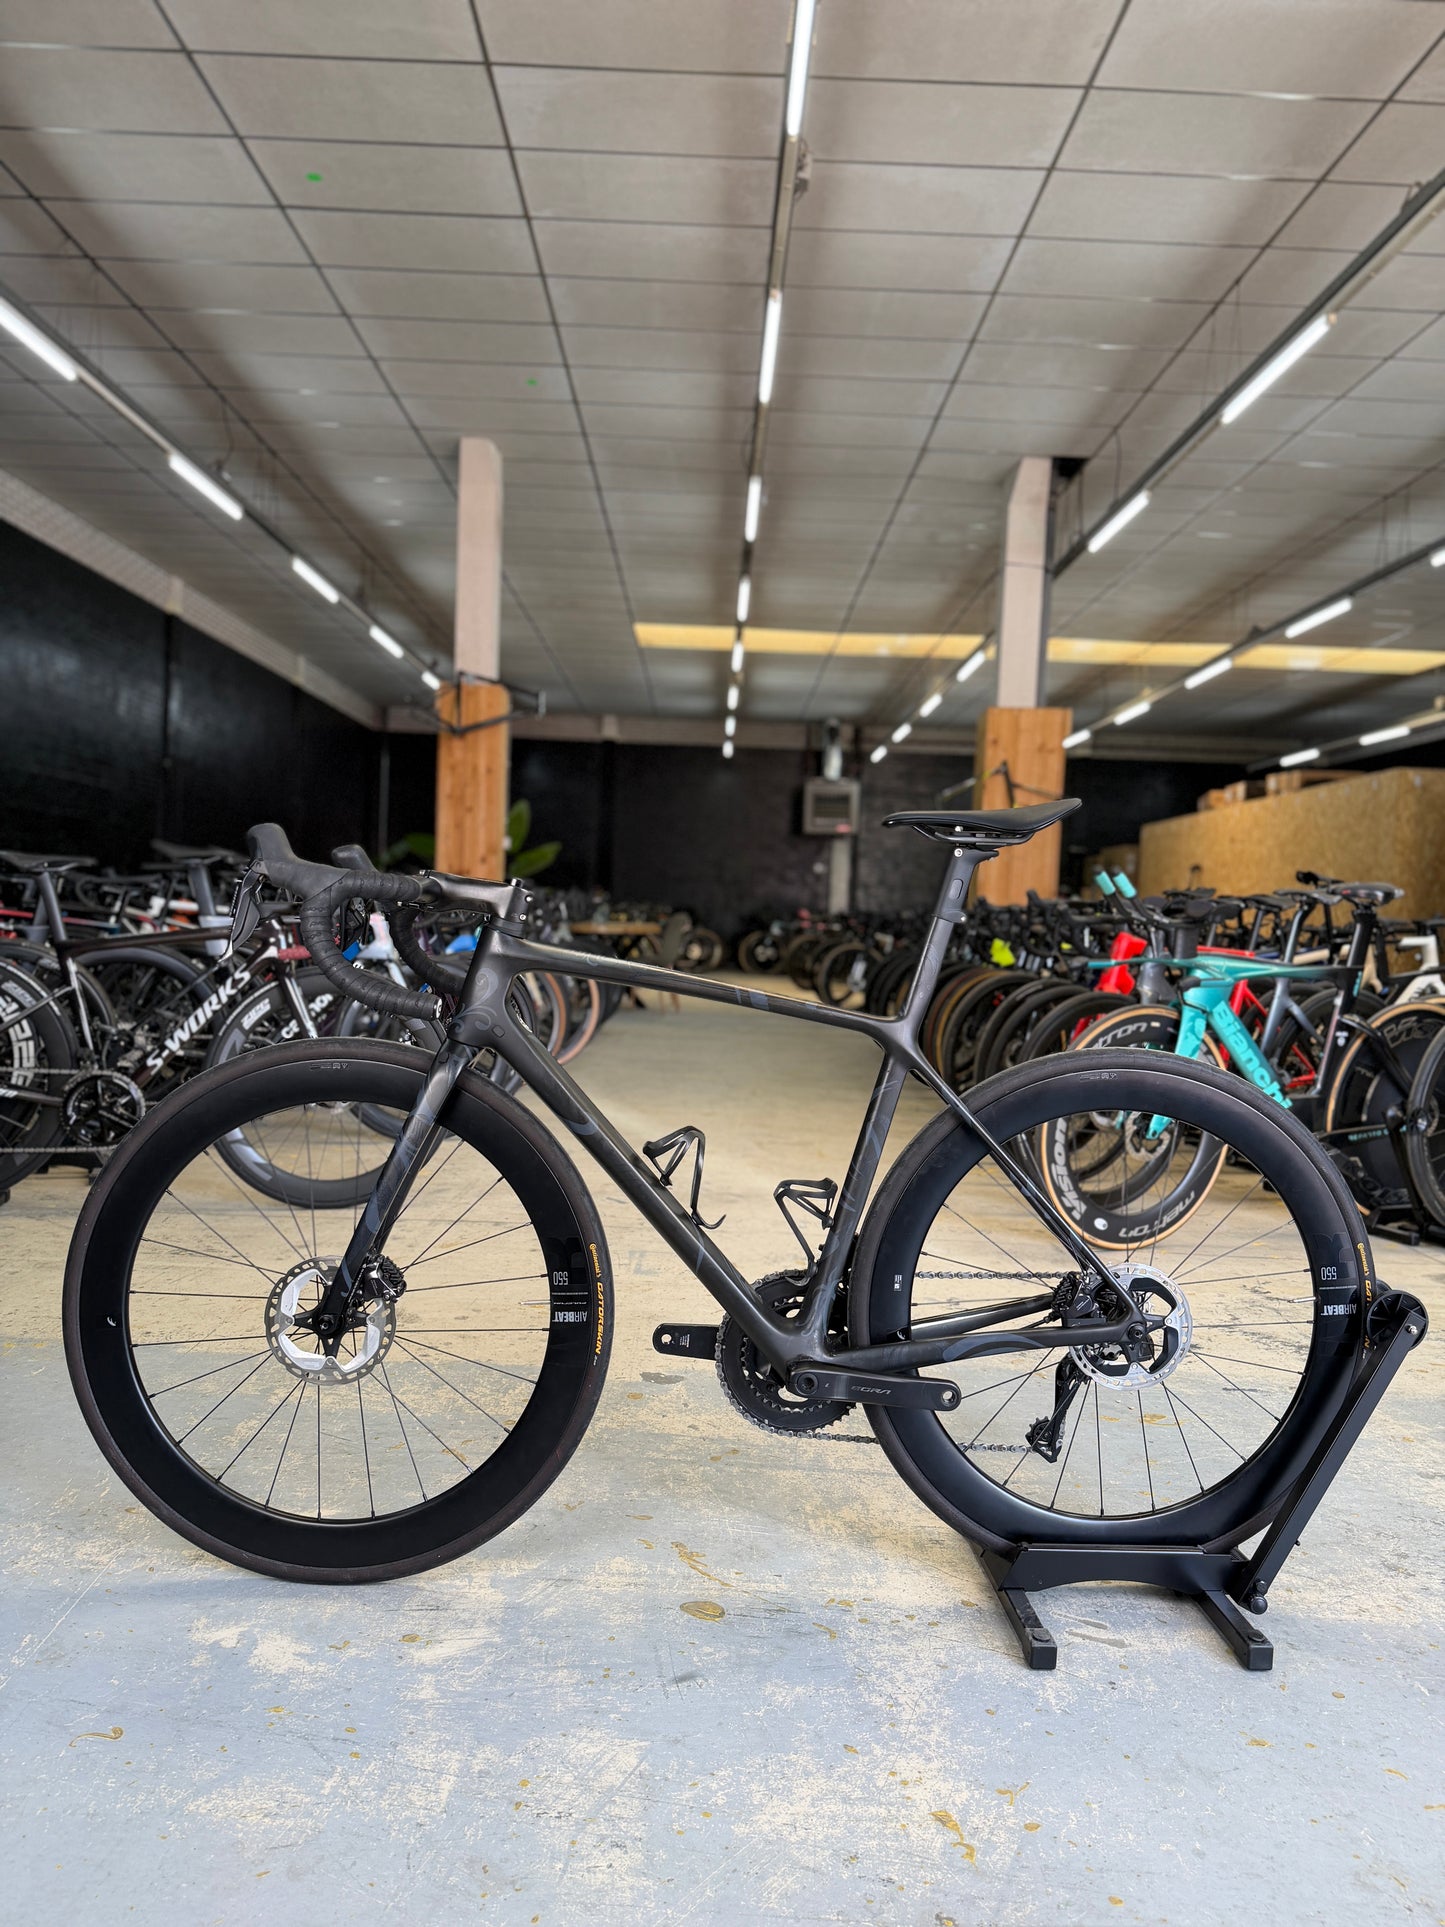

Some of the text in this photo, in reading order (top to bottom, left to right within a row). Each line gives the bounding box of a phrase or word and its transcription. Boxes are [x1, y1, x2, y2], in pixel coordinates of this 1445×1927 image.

[146, 963, 250, 1076] S-WORKS
[552, 1271, 569, 1286] 550
[1320, 1266, 1337, 1281] 550
[552, 1311, 588, 1323] AIRBEAT
[1320, 1303, 1357, 1316] AIRBEAT
[595, 1281, 604, 1355] GATORSKIN
